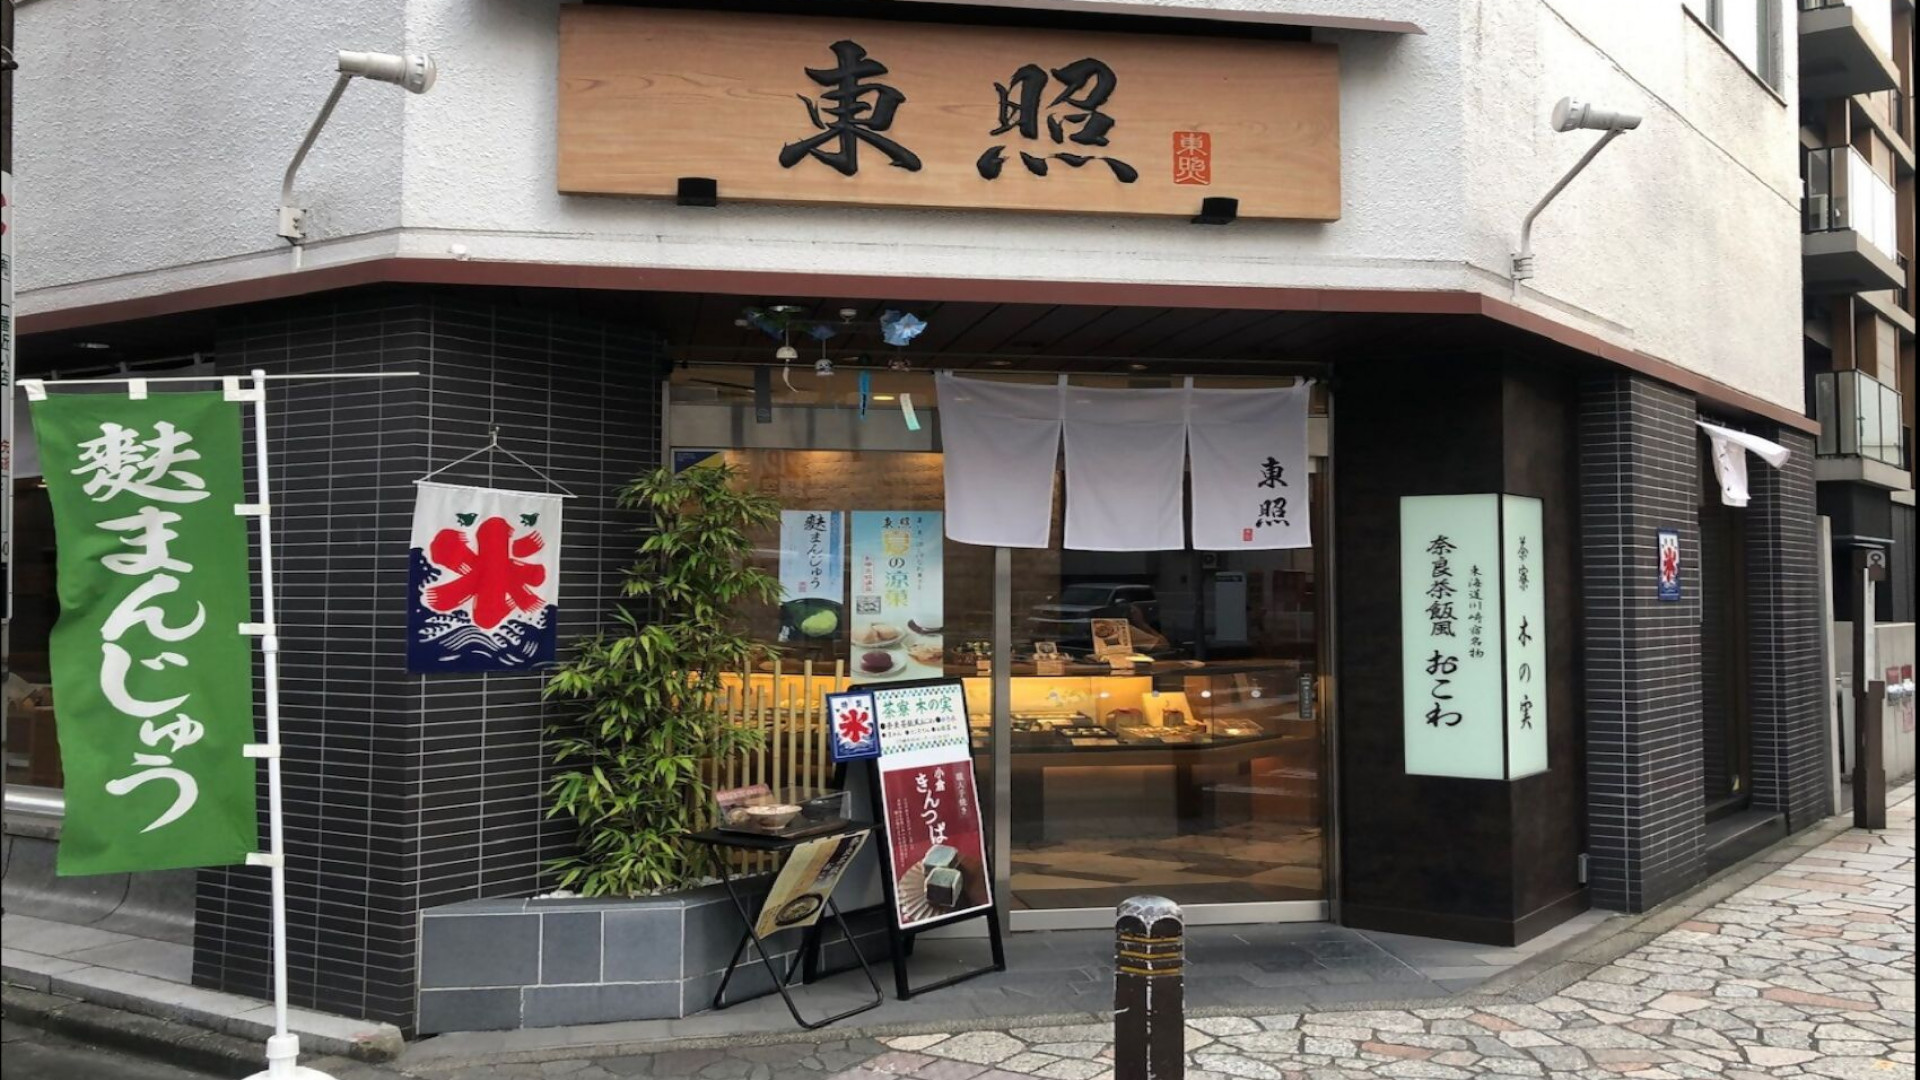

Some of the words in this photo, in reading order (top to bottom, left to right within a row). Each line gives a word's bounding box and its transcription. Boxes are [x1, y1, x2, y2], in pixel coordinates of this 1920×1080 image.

[778, 39, 1139, 184] 東照
[1255, 456, 1290, 528] 東照
[430, 516, 546, 630] 氷
[1468, 565, 1484, 658] 東海道川崎宿名物
[71, 421, 211, 834] 麩まんじゅう
[839, 709, 869, 743] 氷
[915, 773, 948, 845] きんつば
